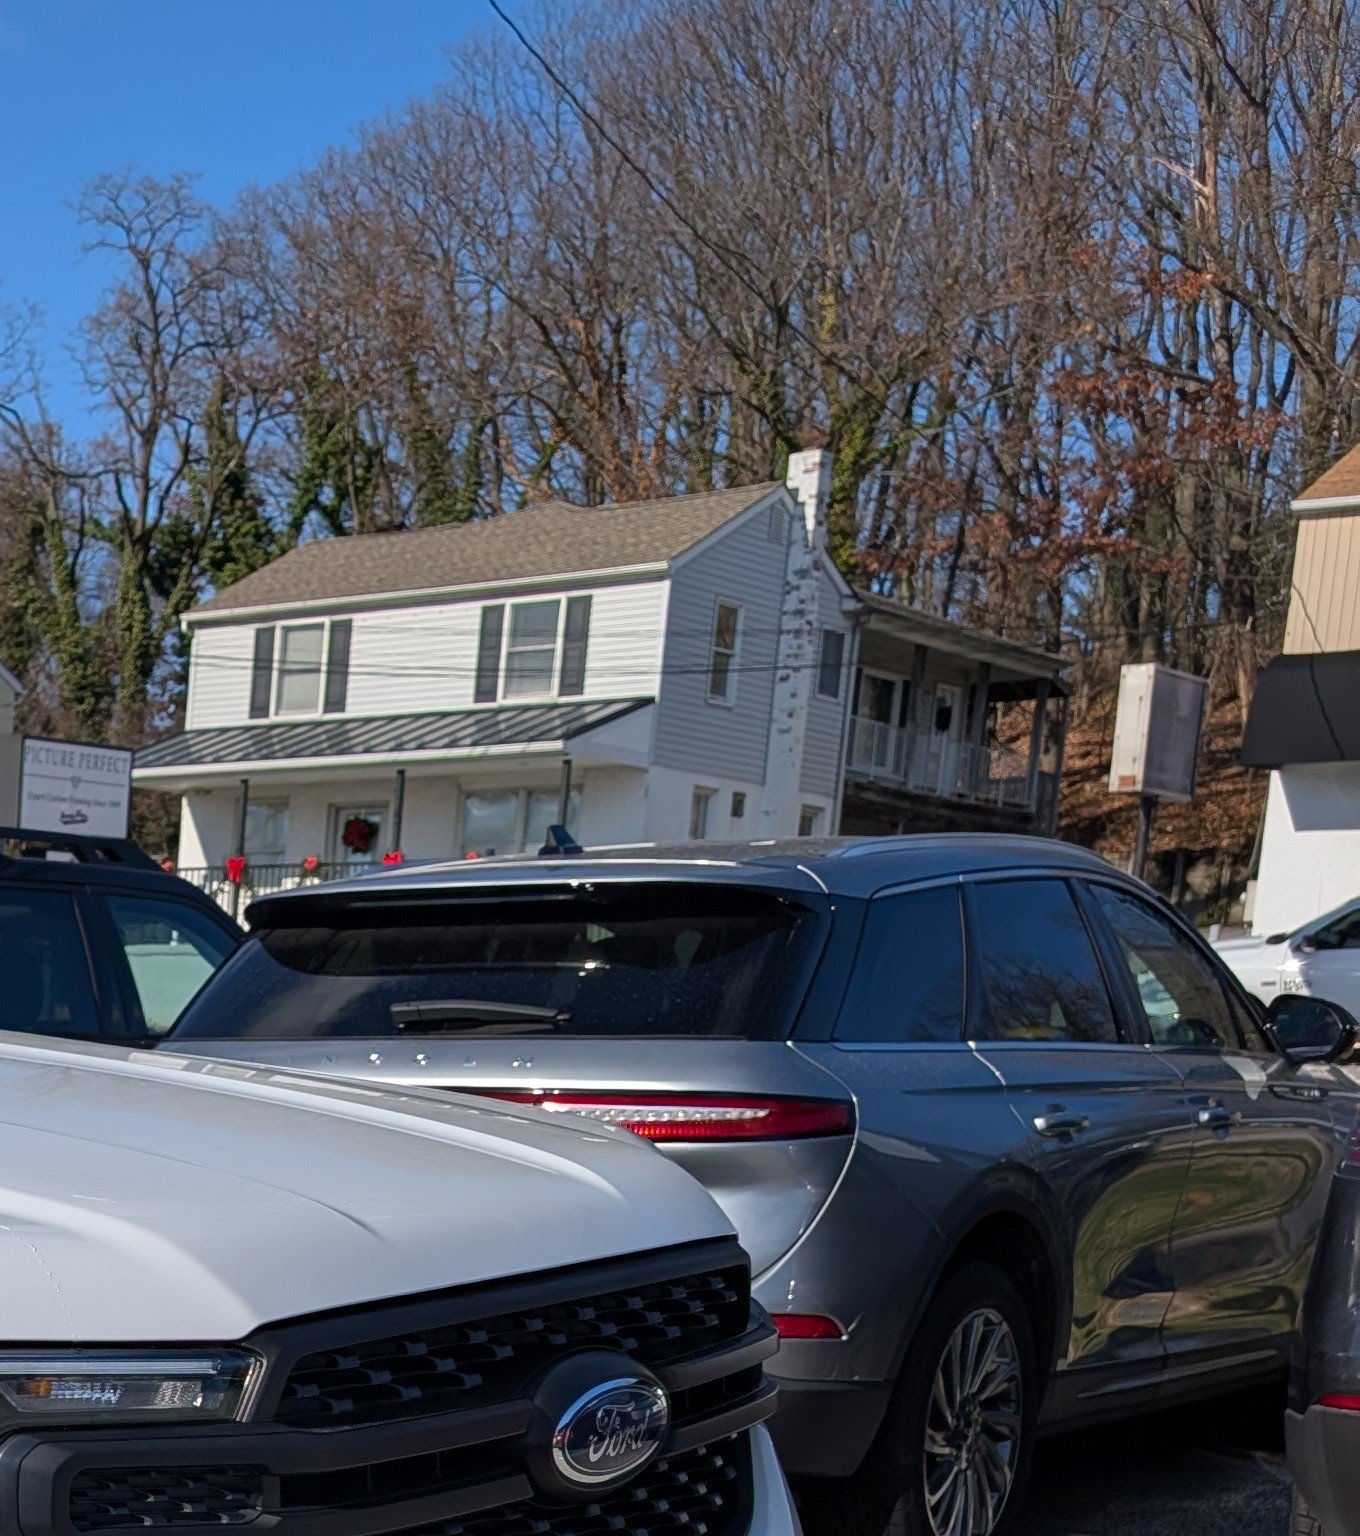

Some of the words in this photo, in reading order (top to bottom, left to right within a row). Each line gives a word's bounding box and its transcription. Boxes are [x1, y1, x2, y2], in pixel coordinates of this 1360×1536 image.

[24, 746, 74, 767] PICTURE
[79, 751, 128, 773] PERFECT
[588, 1400, 651, 1462] Ford
